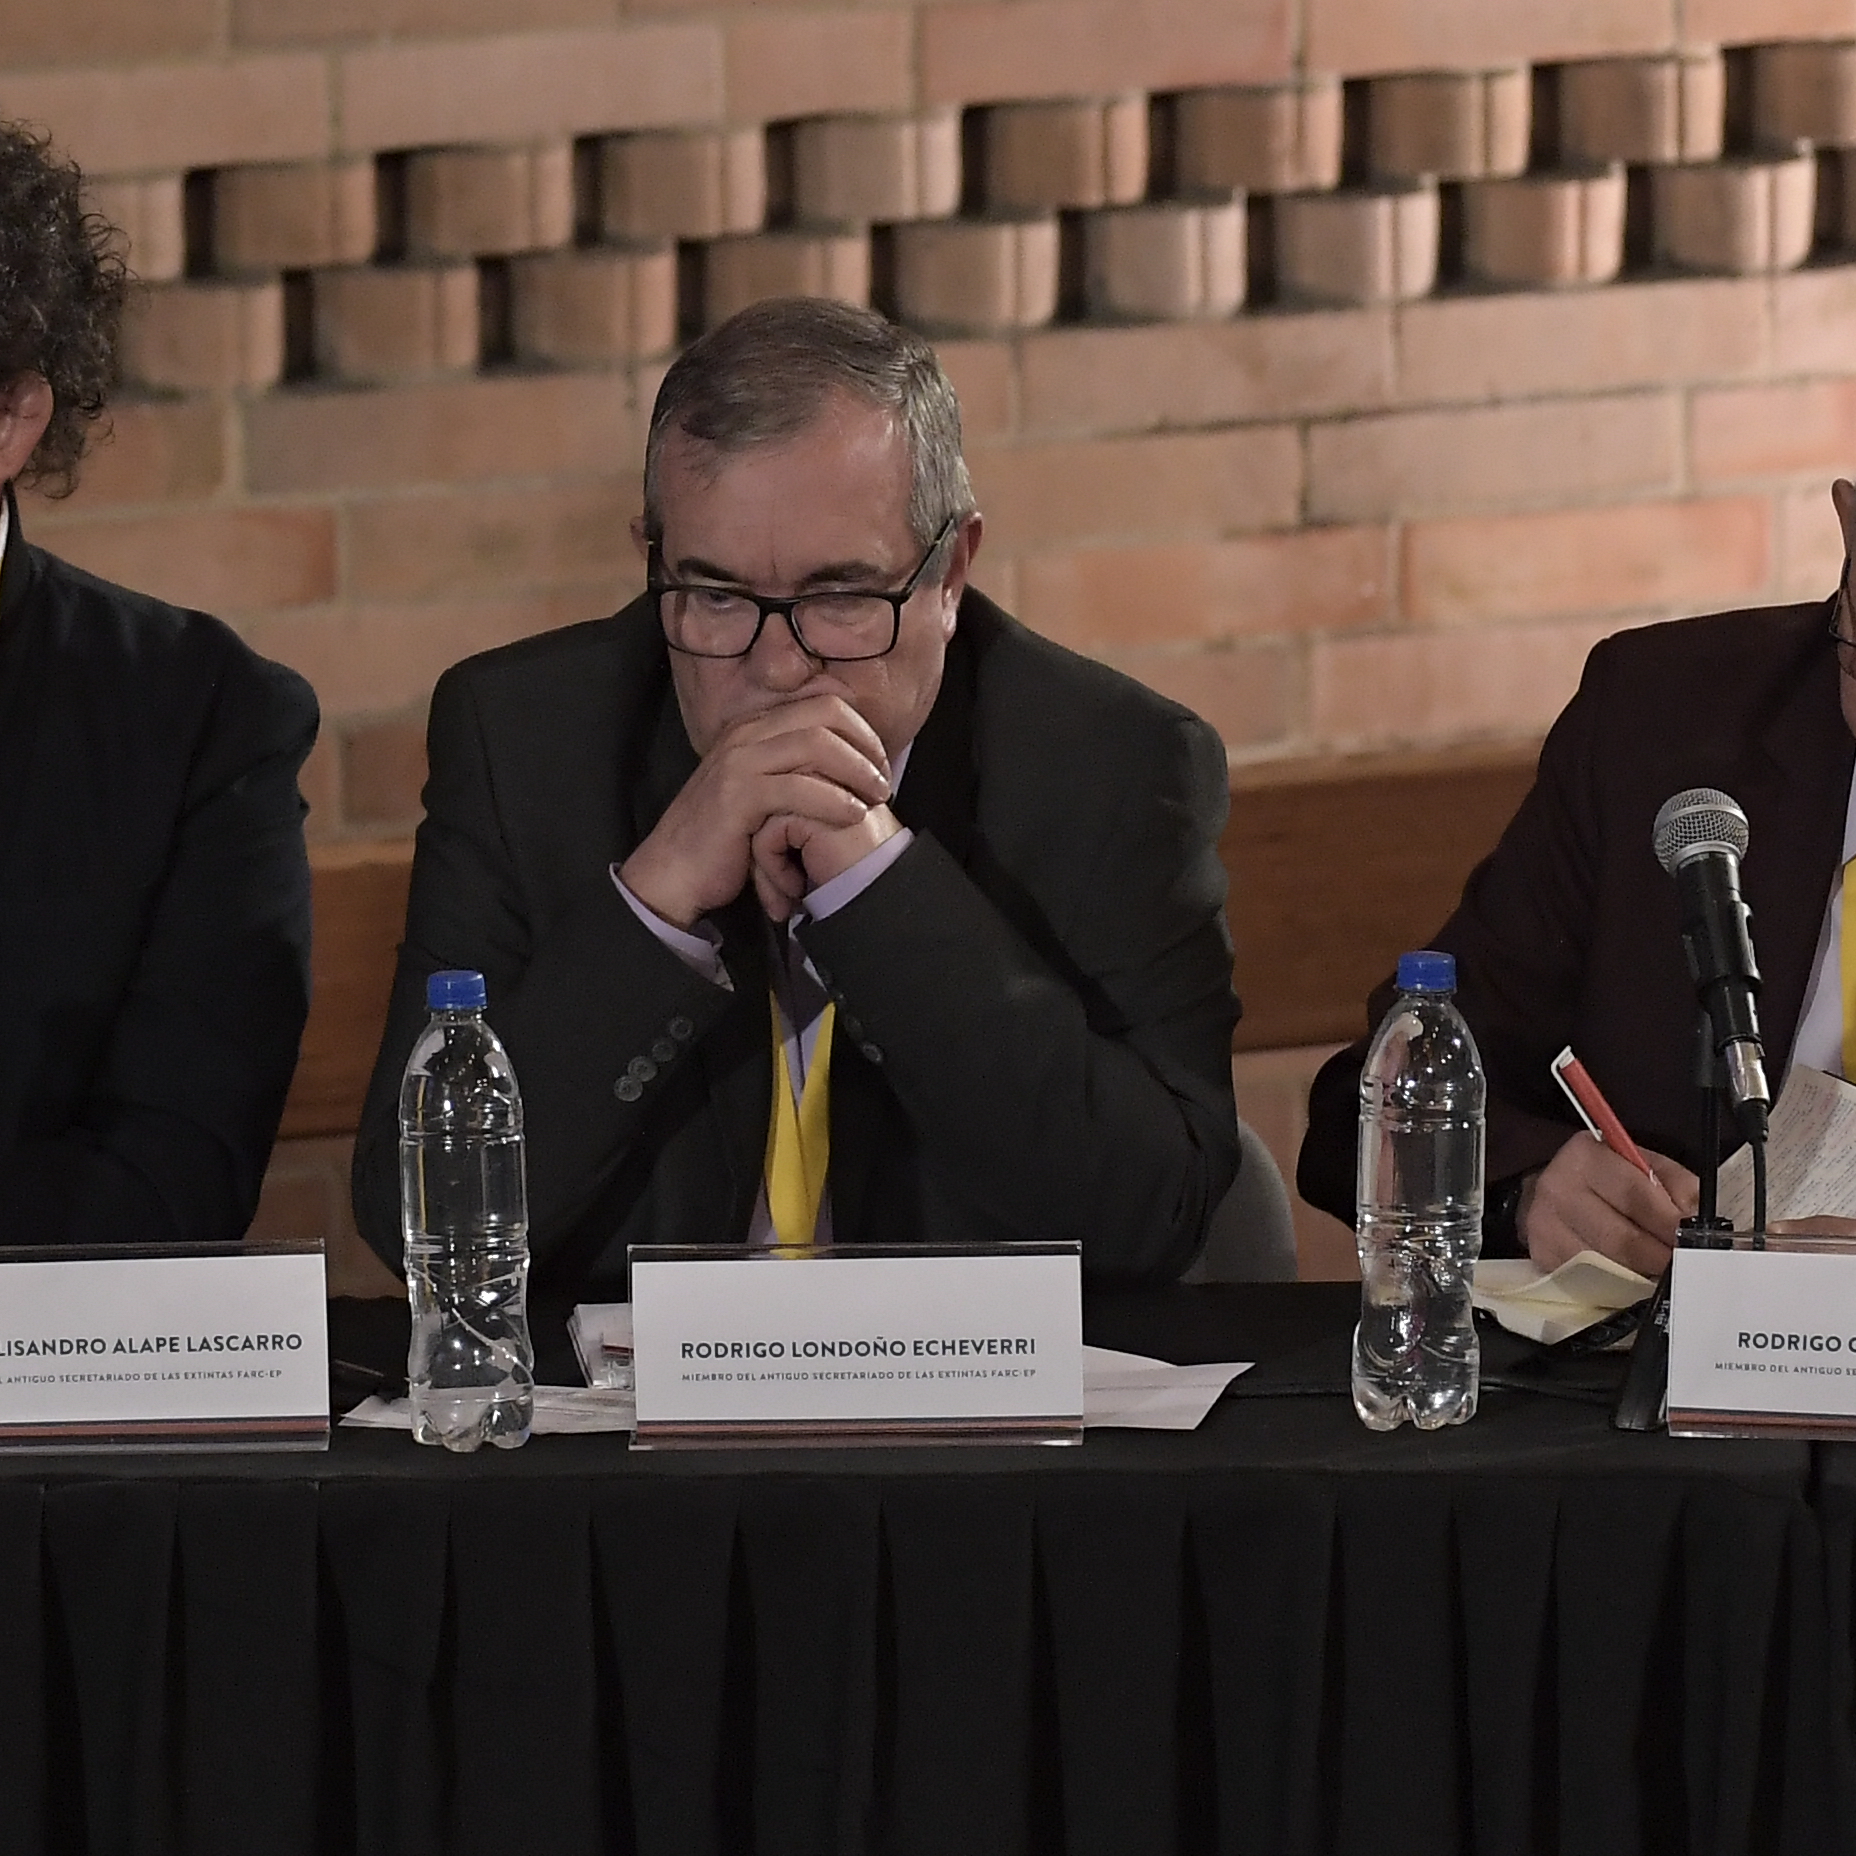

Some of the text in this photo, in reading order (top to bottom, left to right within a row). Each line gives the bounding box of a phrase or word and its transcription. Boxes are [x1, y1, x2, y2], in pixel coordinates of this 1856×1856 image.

[111, 1336, 181, 1355] ALAPE
[186, 1333, 303, 1353] LASCARRO
[681, 1335, 1036, 1359] RODRIGO LONDOÑO ECHEVERRI
[1737, 1331, 1842, 1353] RODRIGO
[6, 1374, 56, 1384] ANTIGUO
[58, 1373, 141, 1383] SECRETARIADO
[143, 1372, 158, 1381] DE
[161, 1372, 181, 1381] LAS
[183, 1370, 234, 1380] EXTINTAS
[681, 1372, 733, 1382] MIEMBRO
[736, 1372, 757, 1382] DEL
[759, 1372, 809, 1381] ANTIGUO
[812, 1371, 895, 1381] SECRETARIADO
[897, 1370, 912, 1380] DE
[915, 1370, 935, 1380] LAS
[937, 1369, 988, 1379] EXTINTAS
